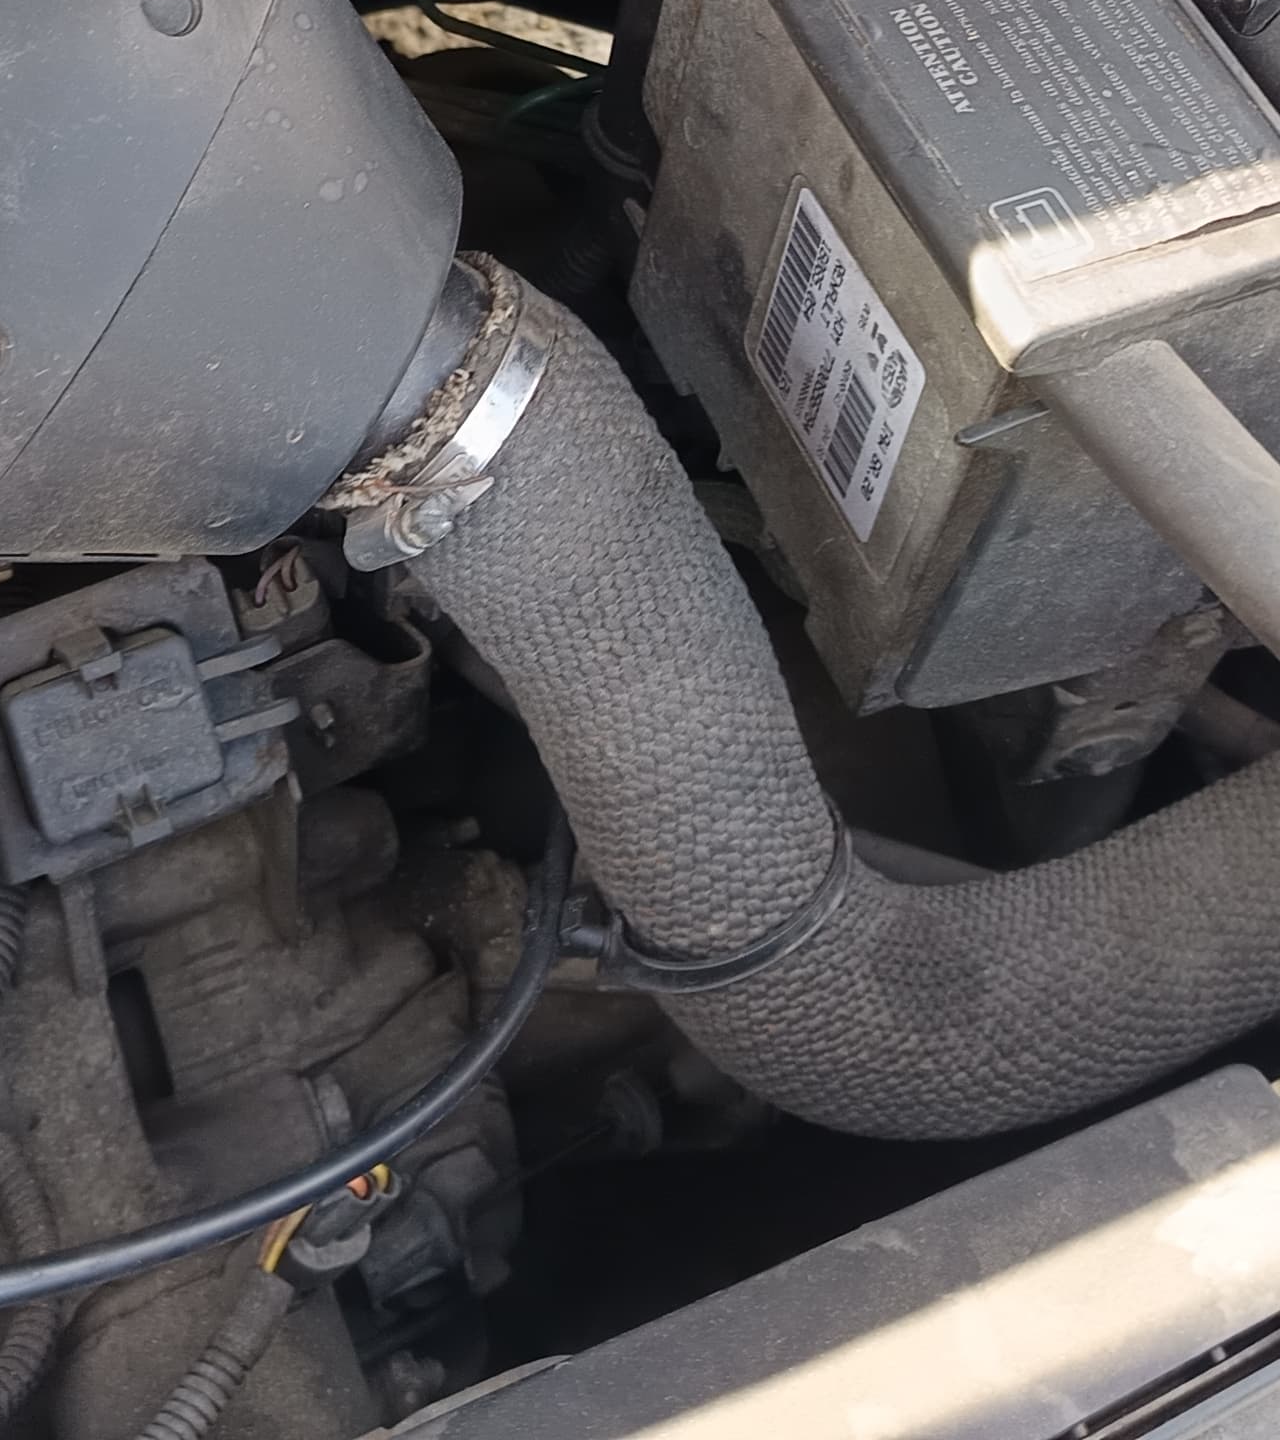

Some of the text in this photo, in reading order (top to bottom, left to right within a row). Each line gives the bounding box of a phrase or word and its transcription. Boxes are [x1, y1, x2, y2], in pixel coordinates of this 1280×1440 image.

[908, 1, 981, 86] CAUTION
[992, 18, 1045, 75] chargeur
[1046, 45, 1065, 57] la
[1066, 25, 1102, 60] while
[1122, 26, 1150, 49] the
[887, 6, 976, 115] ATTENTION
[971, 40, 1016, 88] batterie
[1056, 58, 1078, 74] de
[1094, 60, 1140, 105] battery
[1116, 41, 1167, 92] charger
[1159, 49, 1204, 91] battery
[1069, 75, 1110, 117] bornes
[1143, 52, 1224, 144] disconnected
[1193, 92, 1219, 113] the
[1016, 102, 1060, 146] jamais
[1052, 101, 1096, 144] jamais
[1165, 106, 1216, 159] connect
[819, 256, 847, 331] RENAULT
